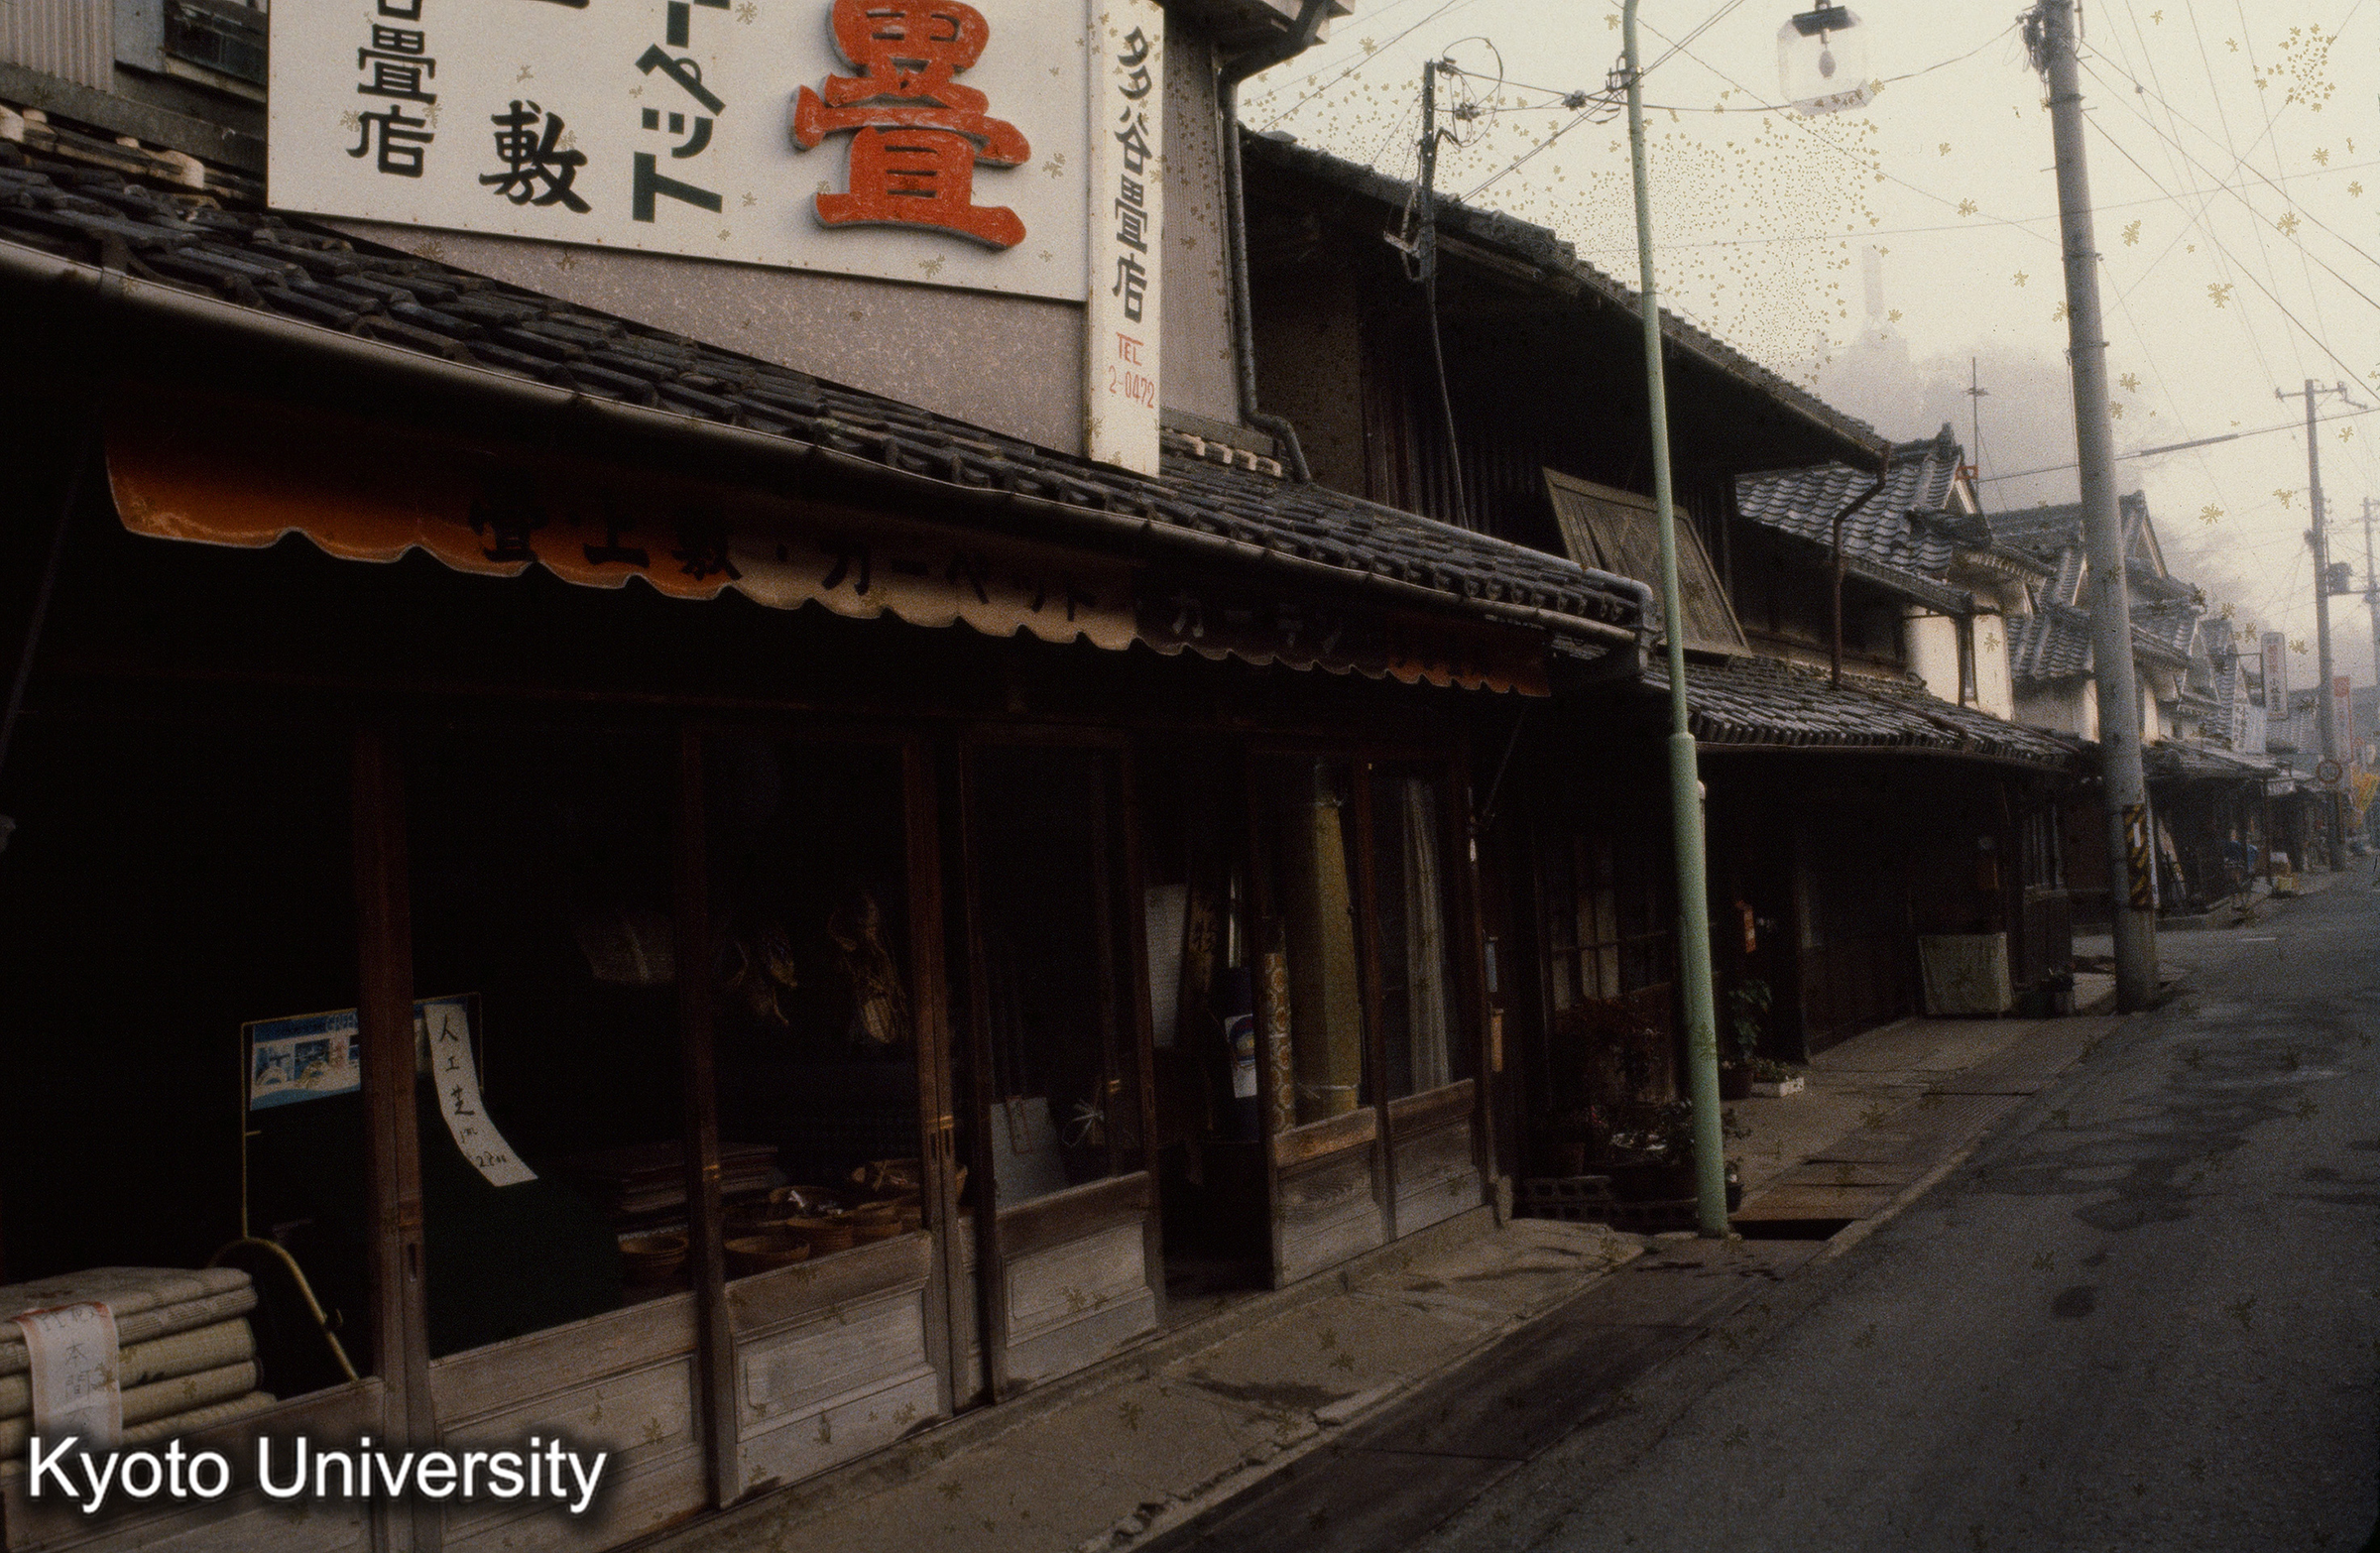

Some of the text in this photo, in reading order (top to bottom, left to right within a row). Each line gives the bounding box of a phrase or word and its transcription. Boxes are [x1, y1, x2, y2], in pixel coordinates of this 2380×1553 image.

[633, 0, 732, 224] ーペット
[792, 0, 1031, 250] 畳
[1108, 364, 1155, 411] 2-0472
[1116, 332, 1144, 367] TEL
[439, 1014, 475, 1117] 人工芝
